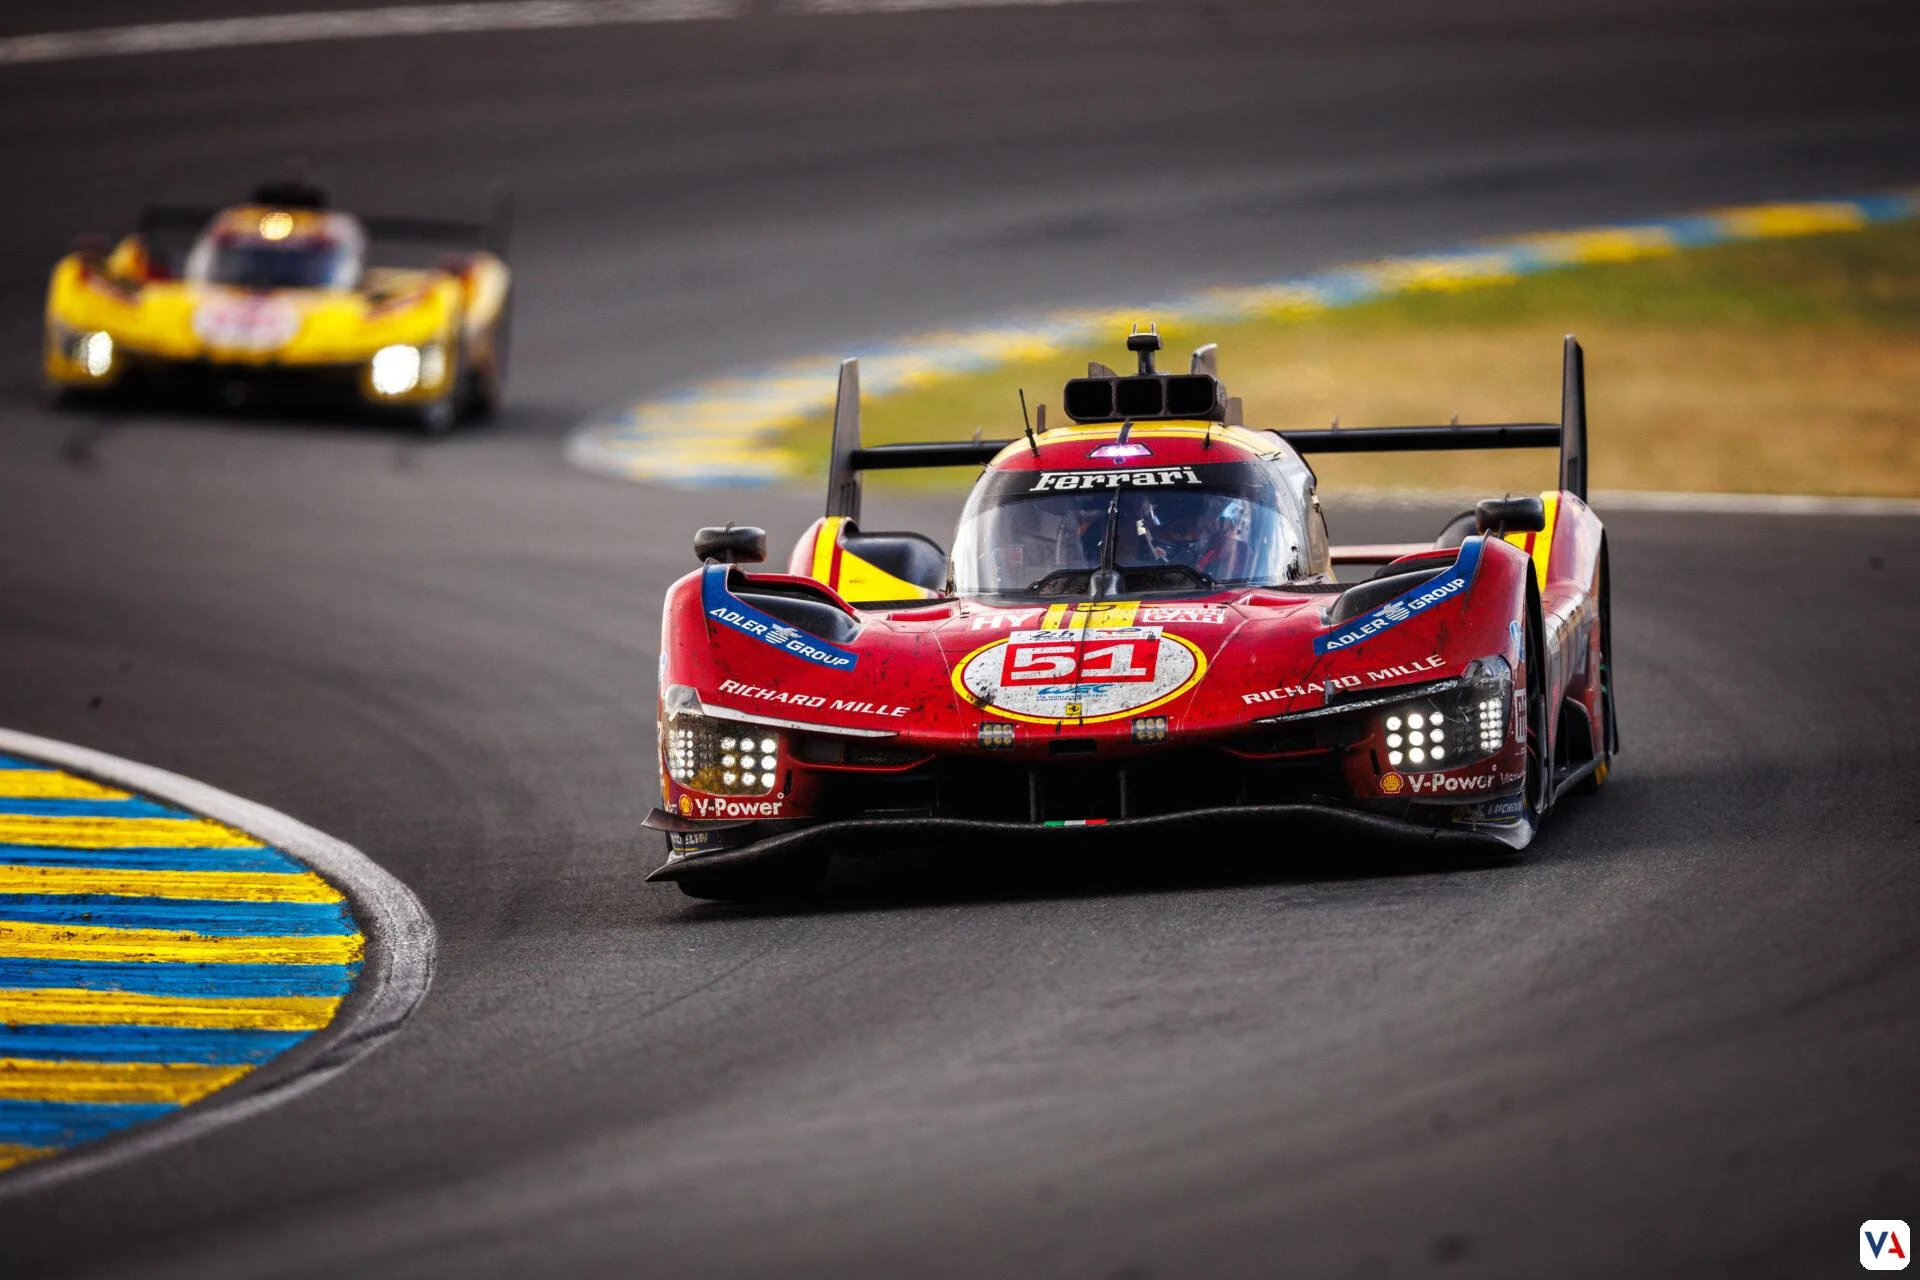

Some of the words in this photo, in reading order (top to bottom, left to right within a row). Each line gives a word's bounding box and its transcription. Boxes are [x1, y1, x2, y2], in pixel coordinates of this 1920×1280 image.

[1030, 467, 1202, 491] Ferrari
[1146, 613, 1219, 622] CAR
[1326, 618, 1389, 650] ADLER
[1407, 578, 1465, 610] GROUP
[709, 607, 768, 635] ADLER
[786, 640, 850, 666] GROUP
[1010, 644, 1147, 680] 51
[1366, 654, 1447, 683] MILLE
[718, 679, 827, 708] RICHARD
[829, 700, 911, 718] MILLE
[1407, 773, 1495, 793] V-Power
[695, 798, 783, 817] V-Power
